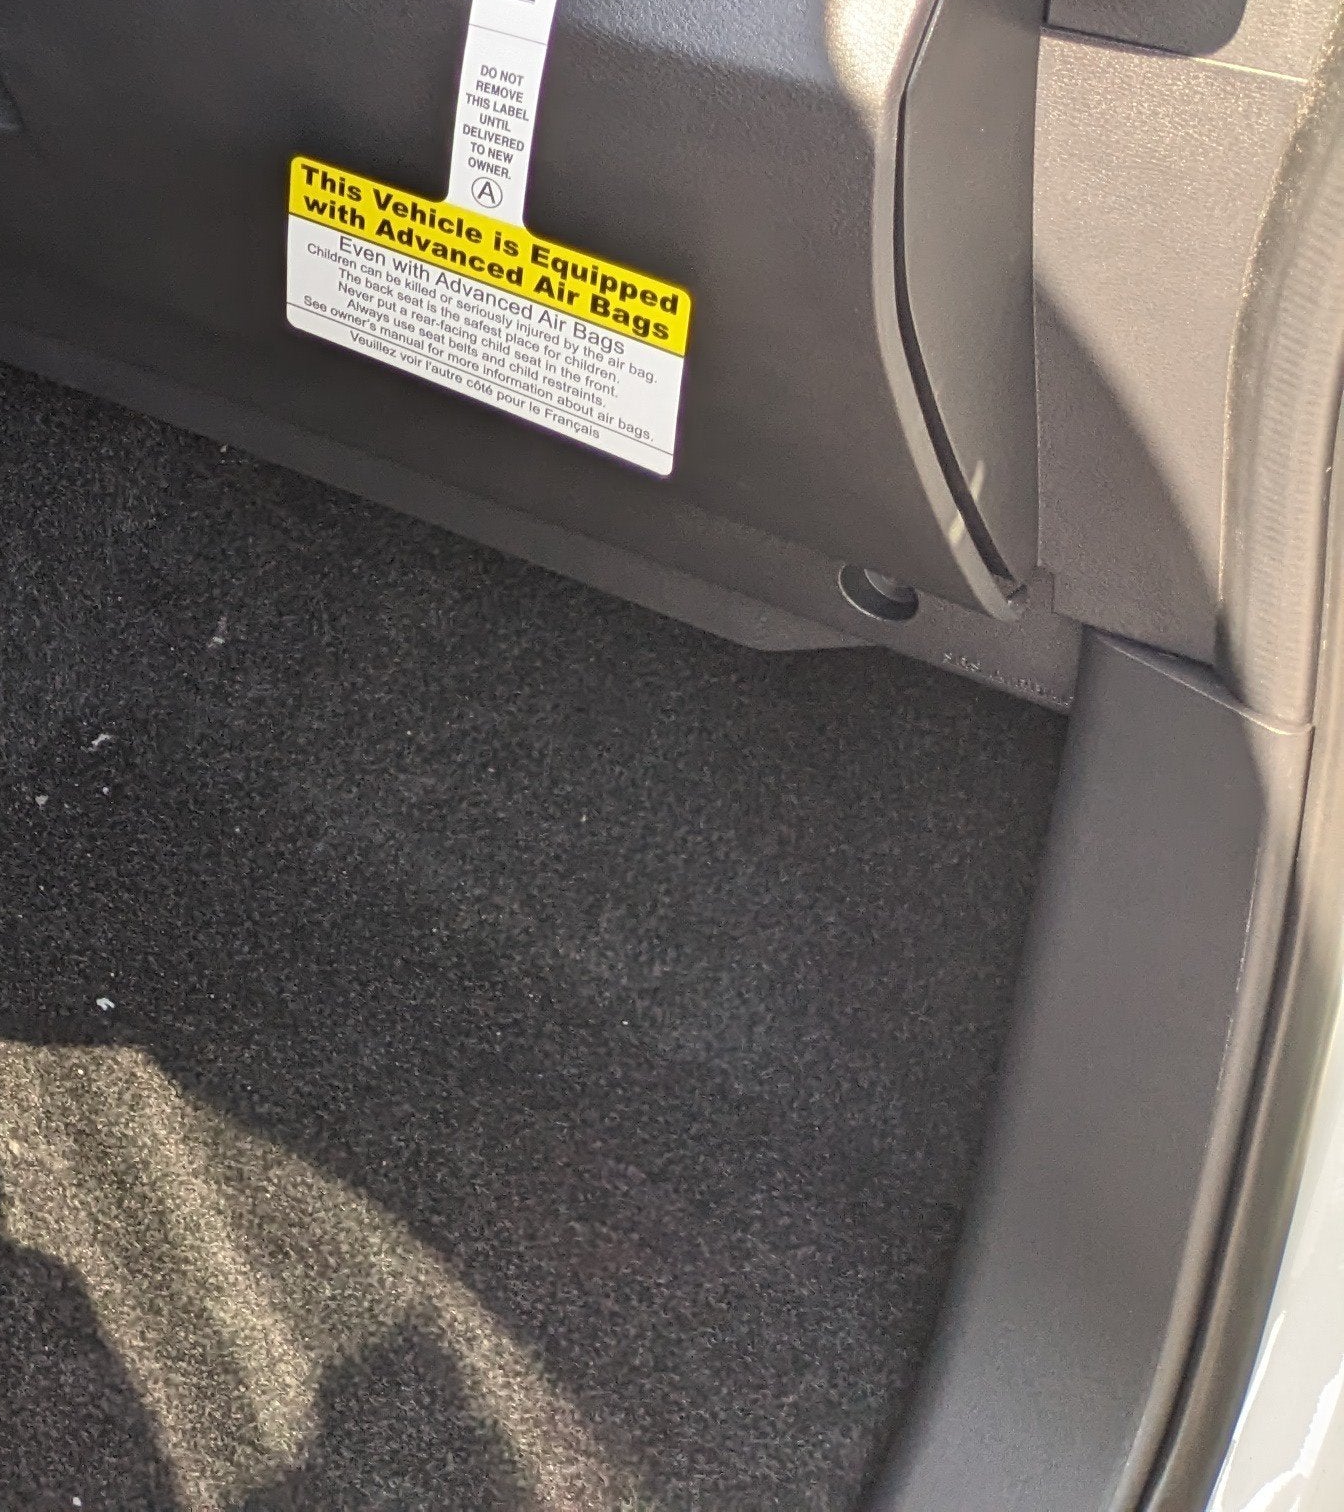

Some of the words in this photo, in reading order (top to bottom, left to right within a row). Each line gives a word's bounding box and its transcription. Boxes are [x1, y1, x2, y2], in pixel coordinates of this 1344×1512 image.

[466, 93, 491, 110] THIS
[493, 102, 529, 122] LABEL
[476, 80, 524, 104] REMOVE
[479, 113, 512, 132] UNTIL
[480, 65, 497, 79] DO
[500, 71, 524, 87] NOT
[462, 124, 525, 152] DELIVERED
[468, 157, 512, 180] OWNER.
[470, 141, 485, 155] TO
[488, 148, 514, 164] NEW
[301, 163, 362, 202] This
[373, 188, 483, 243] Vehicle
[493, 231, 519, 257] is
[531, 243, 679, 315] Equipped
[304, 196, 365, 230] with
[375, 219, 524, 286] Advanced
[533, 275, 580, 306] Air
[590, 293, 669, 340] Bags
[307, 243, 356, 270] Children
[361, 263, 382, 278] can
[386, 270, 401, 285] be
[405, 280, 436, 299] killed
[440, 294, 454, 305] or
[456, 299, 512, 329] seriously
[516, 322, 560, 346] injured
[564, 338, 579, 354] by
[583, 346, 604, 362] the
[608, 357, 625, 371] air
[629, 363, 658, 384] bag.
[338, 268, 361, 284] The
[365, 277, 393, 296] back
[397, 290, 424, 307] seat
[427, 302, 437, 313] is
[441, 306, 460, 322] the
[464, 316, 502, 339] safest
[505, 330, 540, 352] place
[544, 344, 562, 359] for
[565, 354, 620, 384] children.
[338, 282, 374, 303] Never
[377, 296, 397, 312] put
[400, 306, 408, 316] a
[412, 311, 477, 346] rear-facing
[481, 338, 511, 357] child
[514, 351, 542, 369] seat
[545, 359, 557, 372] in
[561, 366, 581, 382] the
[585, 376, 619, 399] front.
[339, 235, 386, 266] Even
[392, 257, 430, 282] with
[435, 272, 533, 320] Advanced
[538, 310, 567, 332] Air
[573, 322, 625, 355] Bags
[303, 295, 327, 313] See
[331, 306, 377, 332] owner's
[380, 325, 424, 351] manual
[428, 341, 445, 358] for
[448, 354, 480, 372] more
[483, 366, 554, 402] information
[557, 394, 594, 417] about
[597, 411, 614, 425] air
[618, 418, 654, 442] bags.
[347, 299, 390, 324] Always
[393, 318, 415, 333] use
[419, 325, 445, 343] seat
[449, 337, 478, 358] belts
[482, 352, 505, 369] and
[509, 363, 538, 381] child
[543, 375, 606, 408] restraints.
[350, 331, 397, 358] Veuillez
[400, 352, 422, 368] voir
[425, 362, 463, 384] l'autre
[466, 378, 493, 396] côté
[496, 390, 526, 409] pour
[529, 401, 541, 415] le
[545, 409, 600, 440] Français
